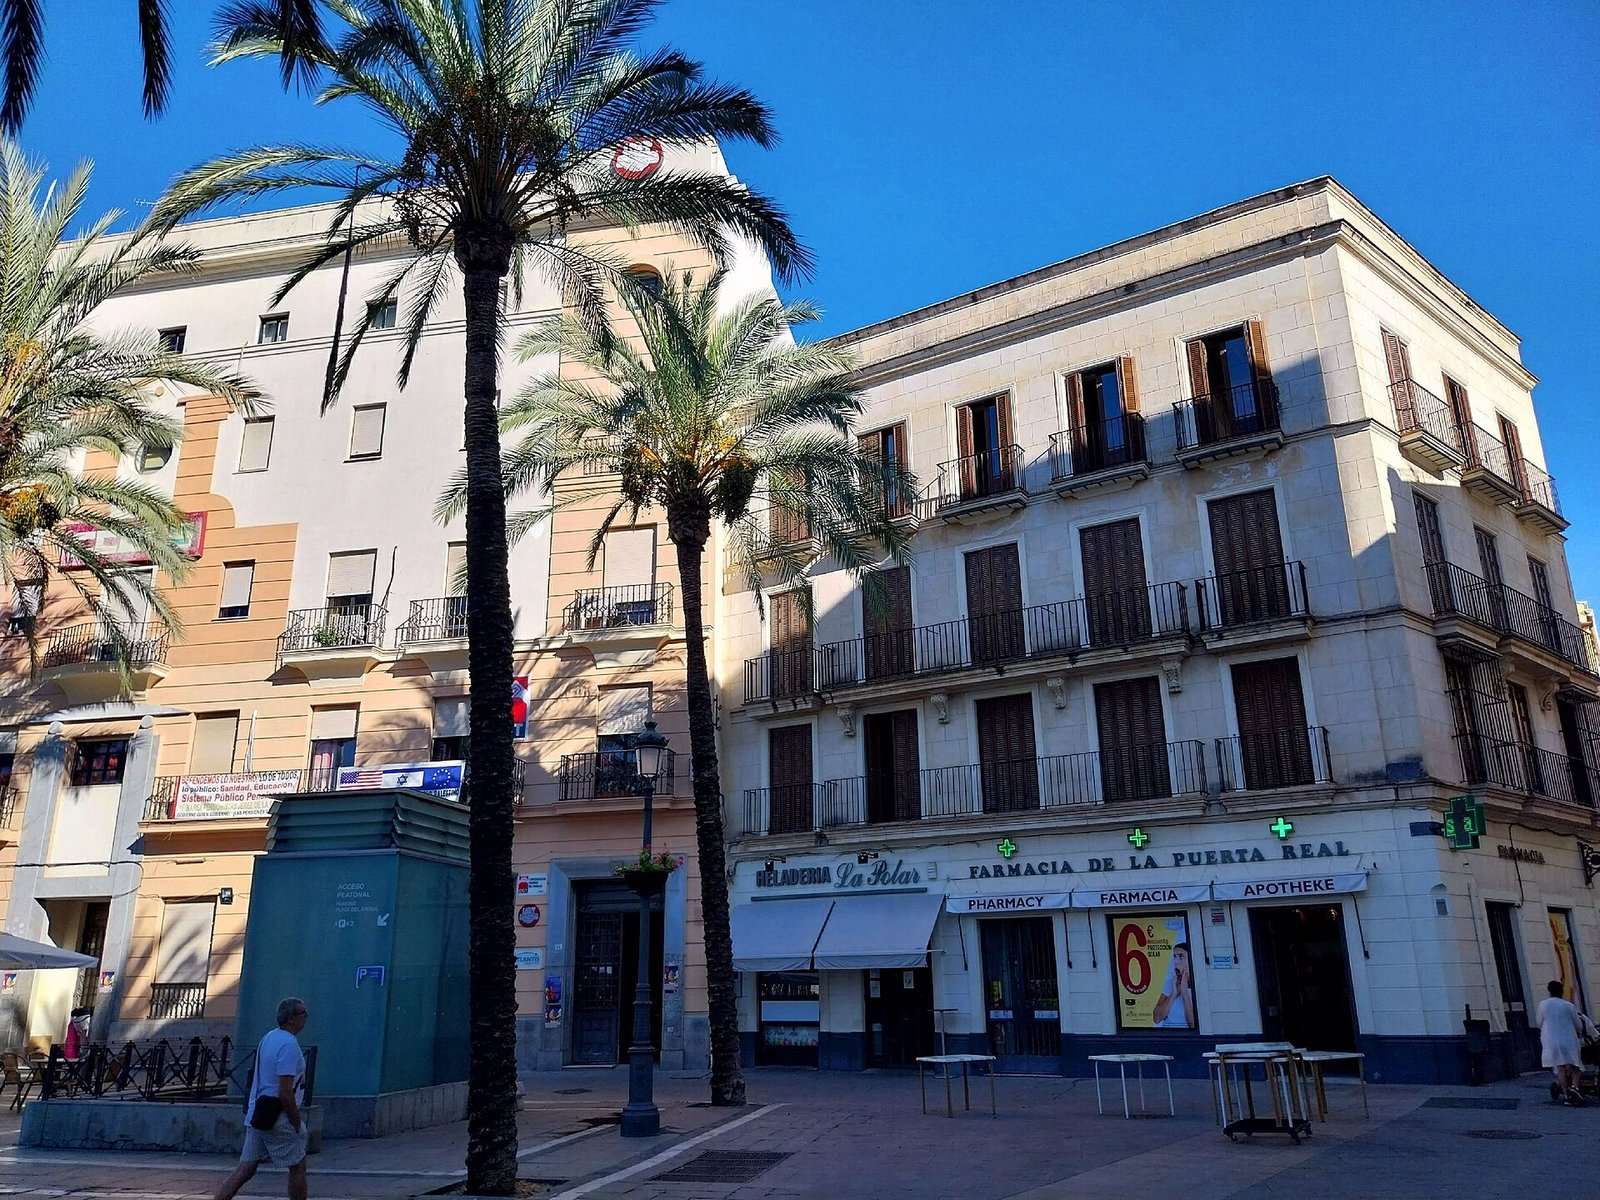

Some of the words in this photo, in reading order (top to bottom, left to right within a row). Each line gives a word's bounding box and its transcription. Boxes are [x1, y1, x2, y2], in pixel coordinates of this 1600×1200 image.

[969, 860, 1073, 879] FARMACIA
[1088, 858, 1115, 873] DE
[1130, 855, 1160, 870] LA
[1173, 848, 1265, 867] PUERTA
[1281, 841, 1349, 860] REAL
[833, 862, 863, 889] La
[866, 859, 920, 886] Polar
[1100, 889, 1178, 905] FARMACIA
[1244, 878, 1335, 897] APOTHEKE
[968, 896, 1044, 910] PHARMACY
[1118, 924, 1151, 994] 6
